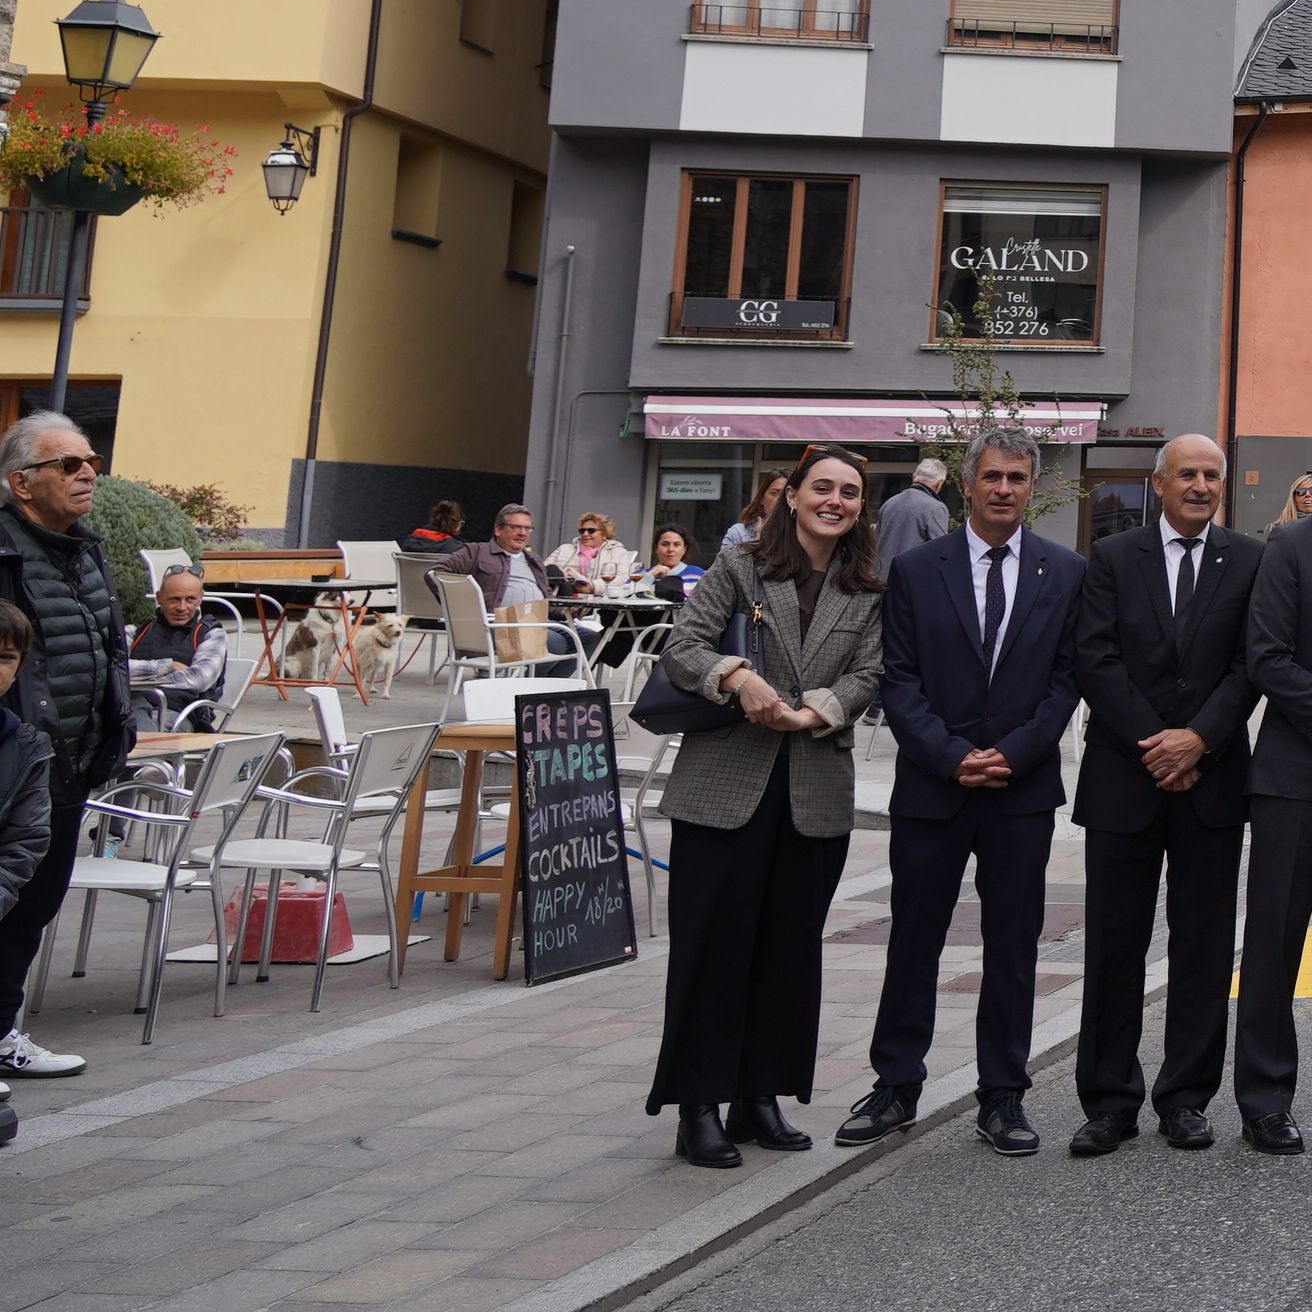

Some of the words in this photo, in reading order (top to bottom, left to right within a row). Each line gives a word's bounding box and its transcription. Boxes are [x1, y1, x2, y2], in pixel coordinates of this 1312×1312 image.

[950, 246, 1089, 272] GALAND
[1007, 291, 1029, 303] Tel.
[740, 300, 778, 323] CG
[1018, 322, 1049, 336] 276
[661, 426, 681, 437] LA
[687, 426, 732, 437] FONT
[534, 742, 608, 787] TAPES
[528, 790, 616, 843] ENTREPANS
[533, 881, 586, 923] HAPPY
[534, 924, 578, 958] HOUR
